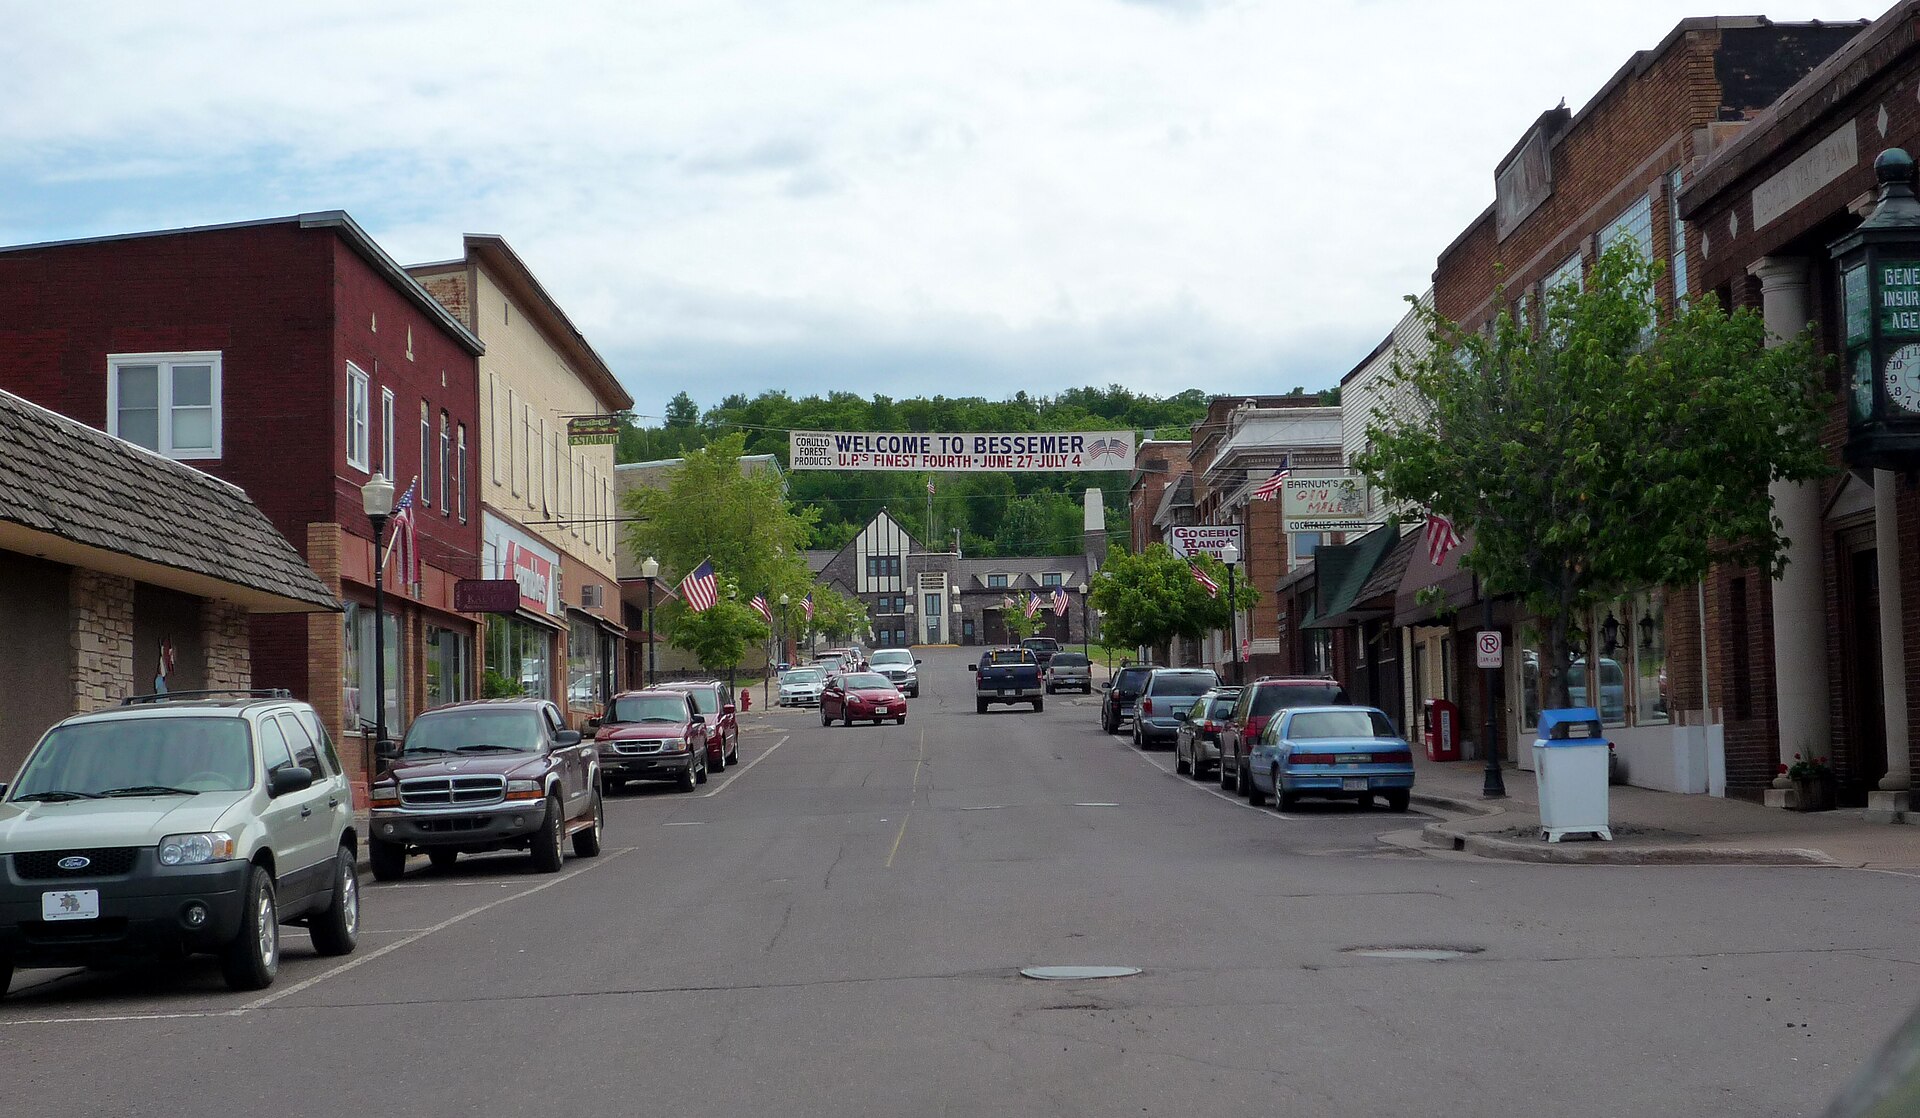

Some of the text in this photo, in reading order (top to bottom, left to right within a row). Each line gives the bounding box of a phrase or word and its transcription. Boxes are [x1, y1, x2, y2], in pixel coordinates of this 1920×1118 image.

[1884, 269, 1920, 286] GENE
[1883, 290, 1920, 307] INSUR
[1892, 312, 1920, 329] AGE
[1892, 360, 1902, 370] 10
[1890, 375, 1897, 383] 9
[1895, 387, 1901, 396] 8
[1905, 396, 1911, 405] 7
[795, 437, 830, 447] CORULLO
[834, 435, 1084, 455] WELCOME TO BESSEMER
[799, 447, 827, 457] FOREST
[794, 456, 832, 466] PRODUCTS
[873, 454, 917, 468] FINEST
[1071, 454, 1082, 468] 4
[1287, 480, 1339, 489] BARNUM'S
[1296, 489, 1328, 501] GIN
[1174, 527, 1239, 538] GOGEBIC
